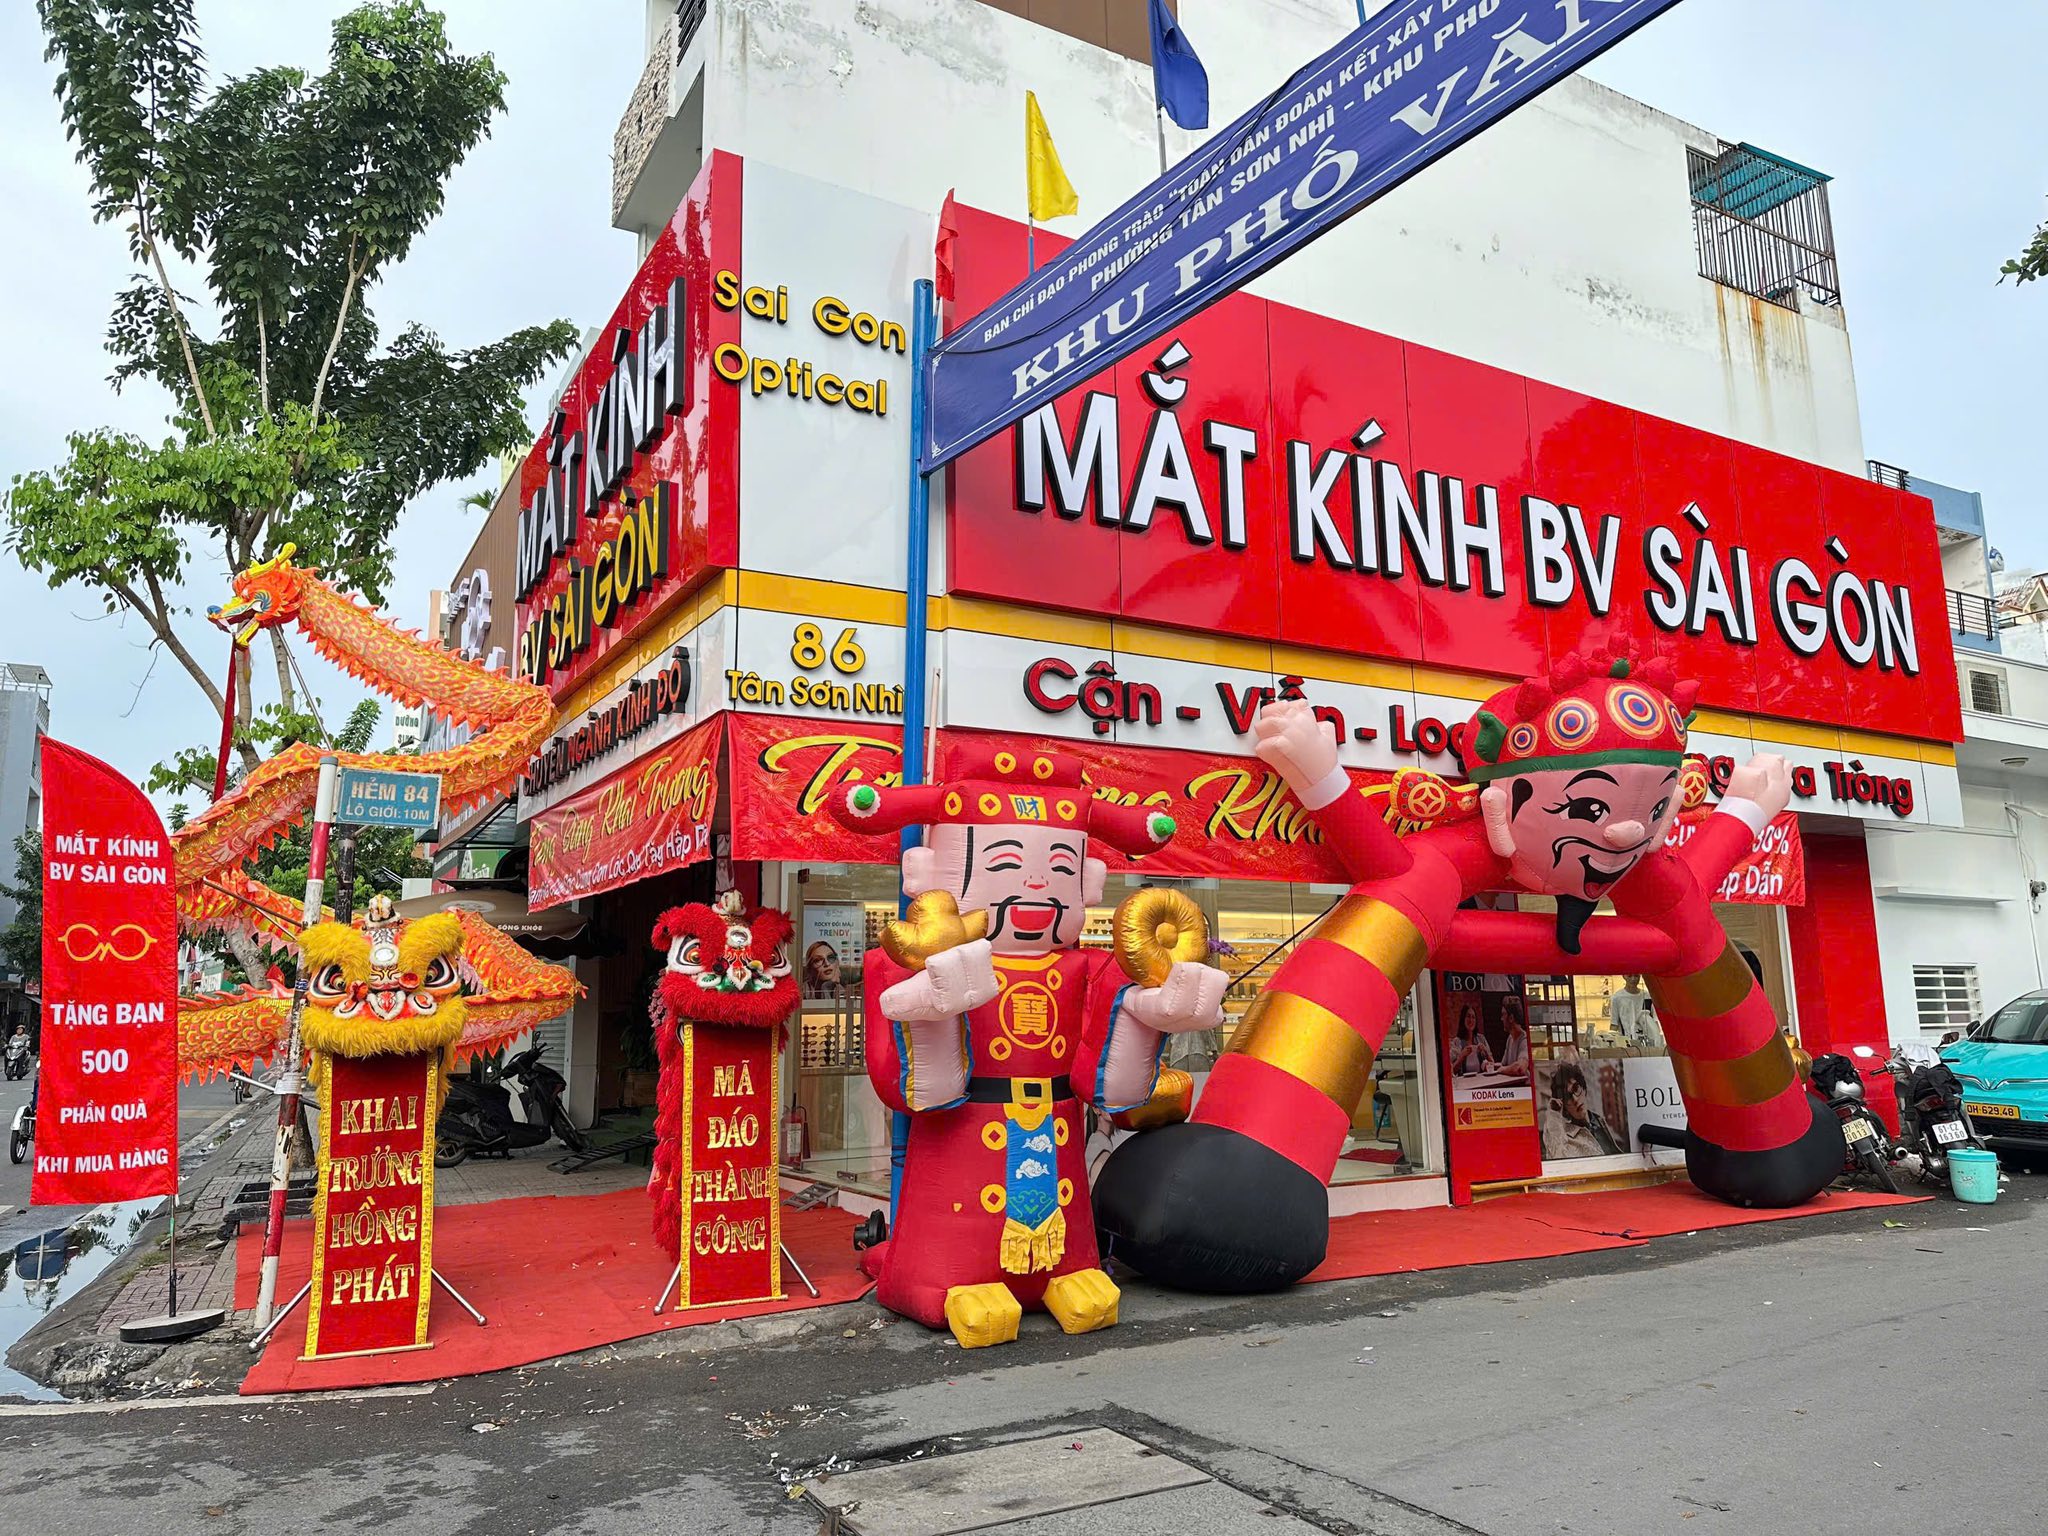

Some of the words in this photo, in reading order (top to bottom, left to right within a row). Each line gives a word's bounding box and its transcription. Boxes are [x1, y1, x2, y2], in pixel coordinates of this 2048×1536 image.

[984, 318, 1009, 343] BAN
[1038, 276, 1064, 304] ĐẠO
[1068, 237, 1118, 282] PHONG
[1122, 204, 1164, 242] TRÀO
[1230, 124, 1270, 165] DÂN
[1275, 80, 1333, 133] ĐOÀN
[1339, 45, 1381, 87] KẾT
[1387, 4, 1434, 53] XÂY
[1091, 222, 1173, 292] PHƯỜNG
[1178, 187, 1223, 229] TÂN
[1230, 146, 1281, 194] SƠN
[1289, 105, 1335, 154] NHÌ
[1363, 43, 1423, 101] KHU
[1012, 281, 1150, 400] KHU
[1174, 134, 1359, 296] PHỐ
[713, 269, 788, 324] Sai
[812, 296, 906, 354] Gon
[713, 342, 887, 416] Optical
[514, 406, 584, 603] MẮT
[585, 276, 686, 518] KÍNH
[1015, 338, 1257, 550] MẮT
[1287, 418, 1505, 598] KÍNH
[1521, 494, 1621, 617] BV
[1643, 501, 1758, 644] SÀI
[1769, 536, 1920, 676] GÒN
[548, 556, 593, 670] SÀI
[592, 479, 670, 628] GÒN
[791, 622, 866, 674] 86
[616, 678, 658, 740] KÍNH
[725, 669, 785, 705] Tân
[790, 675, 850, 710] Sơn
[853, 682, 905, 714] Nhì
[1022, 657, 1162, 734] Cận
[1216, 675, 1347, 746] Vn
[1823, 759, 1915, 817] Tròng
[351, 777, 397, 801] HẺM
[403, 785, 429, 804] 84
[1016, 797, 1041, 820] 财
[404, 809, 430, 821] 10M
[56, 830, 99, 855] MẮT
[107, 835, 159, 858] KÍNH
[50, 862, 75, 881] BV
[81, 861, 116, 883] SÀI
[123, 862, 167, 885] GÒN
[1745, 860, 1784, 896] Dẫn
[819, 929, 850, 937] TRENDY
[50, 1000, 108, 1030] TẶNG
[116, 1002, 164, 1029] BẠN
[1011, 992, 1050, 1037] 寶
[81, 1049, 129, 1075] 500
[712, 1060, 755, 1097] MÃ
[60, 1099, 106, 1124] PHẦN
[111, 1098, 147, 1123] QUÀ
[339, 1096, 418, 1135] KHAI
[1472, 1090, 1497, 1100] KODAK
[1498, 1088, 1515, 1099] Lens
[1635, 1087, 1681, 1108] BOL
[707, 1106, 759, 1149] ĐÁO
[37, 1155, 69, 1173] KHI
[75, 1154, 114, 1174] MUA
[119, 1147, 168, 1169] HÀNG
[329, 1145, 424, 1193] TRƯƠNG
[691, 1160, 772, 1203] THÀNH
[330, 1195, 417, 1249] HỒNG
[694, 1214, 766, 1256] CÔNG
[330, 1253, 415, 1306] PHÁT
